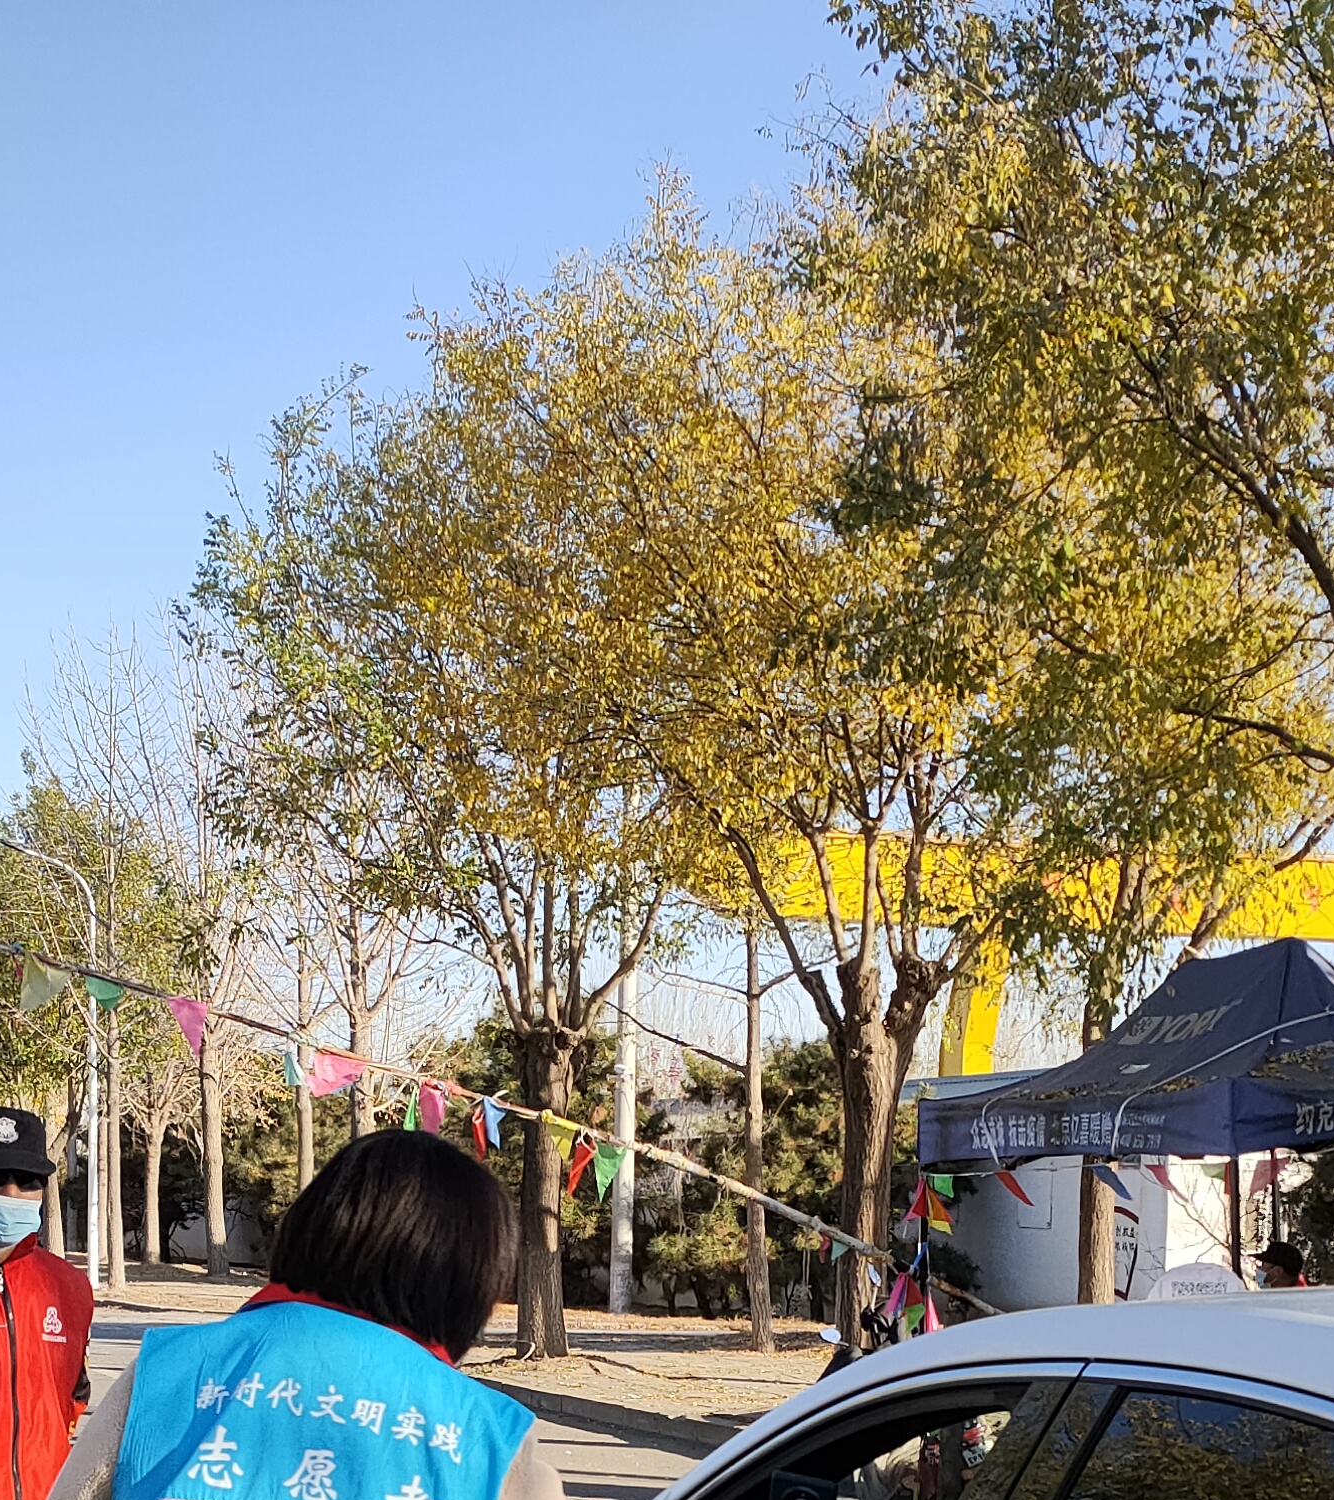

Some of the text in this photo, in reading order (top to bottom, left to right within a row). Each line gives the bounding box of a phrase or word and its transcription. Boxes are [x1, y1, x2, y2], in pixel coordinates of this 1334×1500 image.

[196, 1372, 462, 1464] 新时代文明实践
